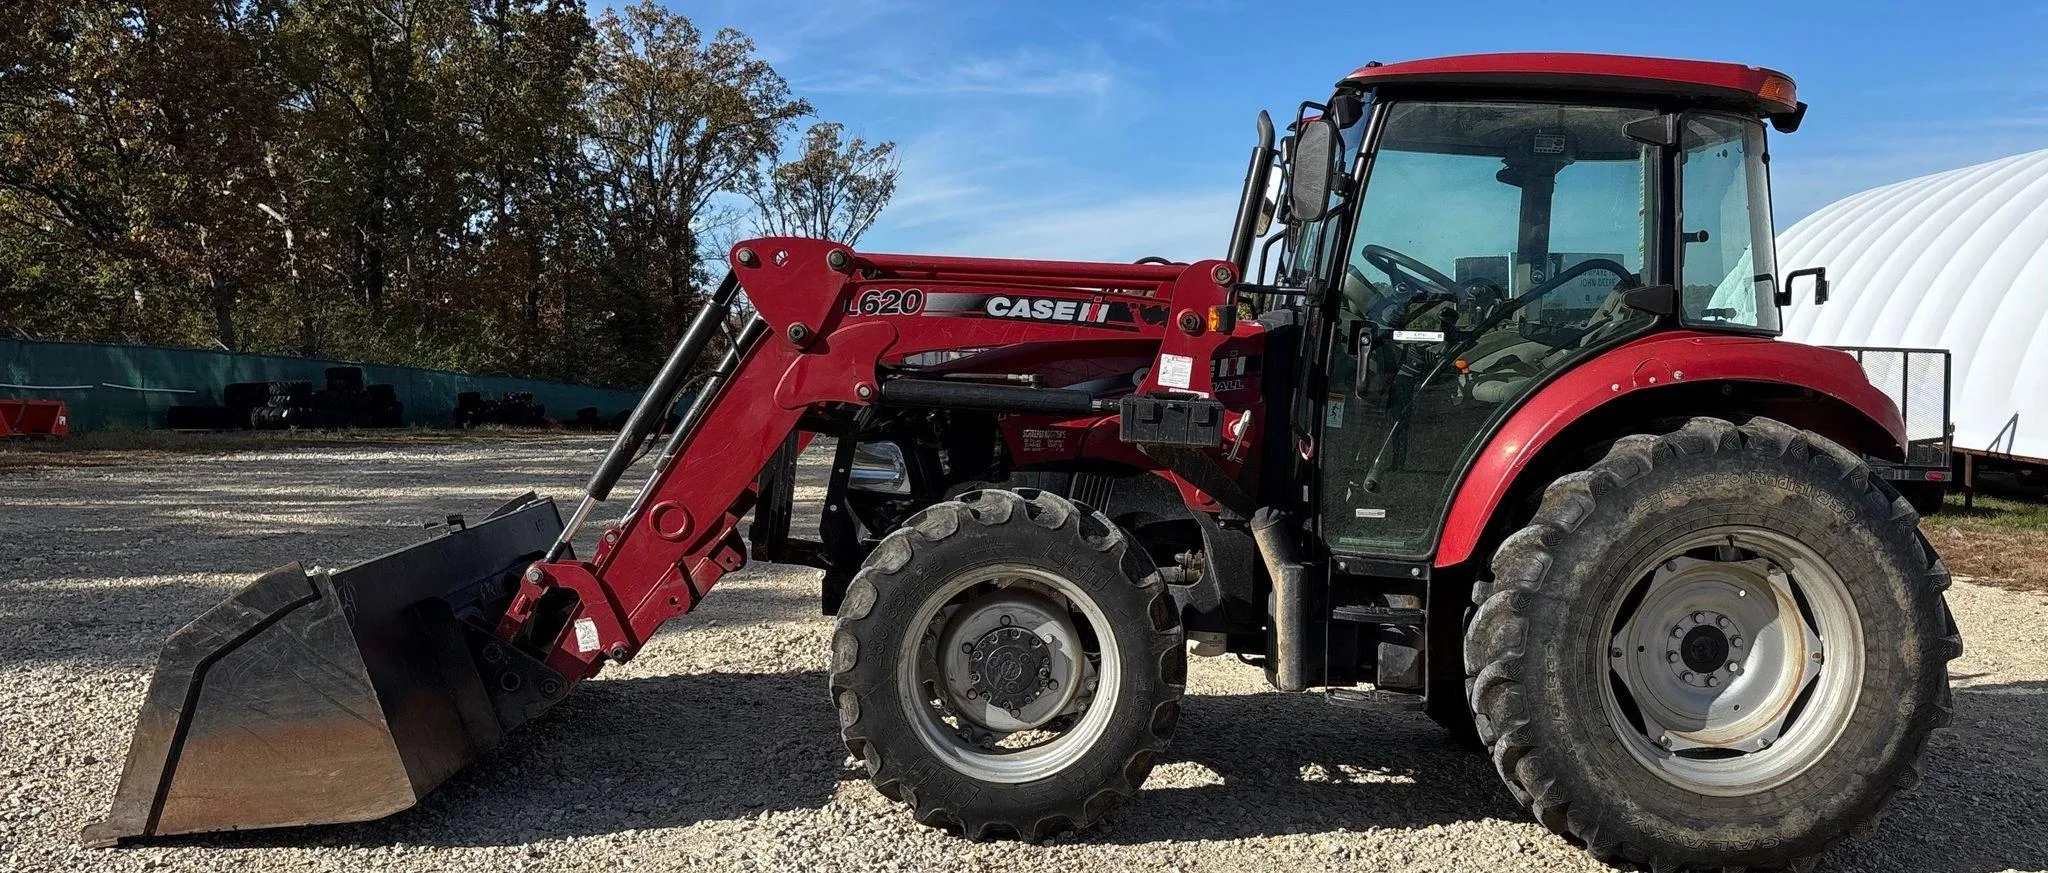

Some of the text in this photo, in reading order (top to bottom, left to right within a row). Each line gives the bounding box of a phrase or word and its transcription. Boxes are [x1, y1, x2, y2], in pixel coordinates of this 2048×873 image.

[1580, 278, 1616, 287] JOHN DEERE
[843, 288, 924, 317] L620
[986, 296, 1077, 321] CASE
[1750, 470, 1813, 498] Radial
[1813, 487, 1858, 523] 850
